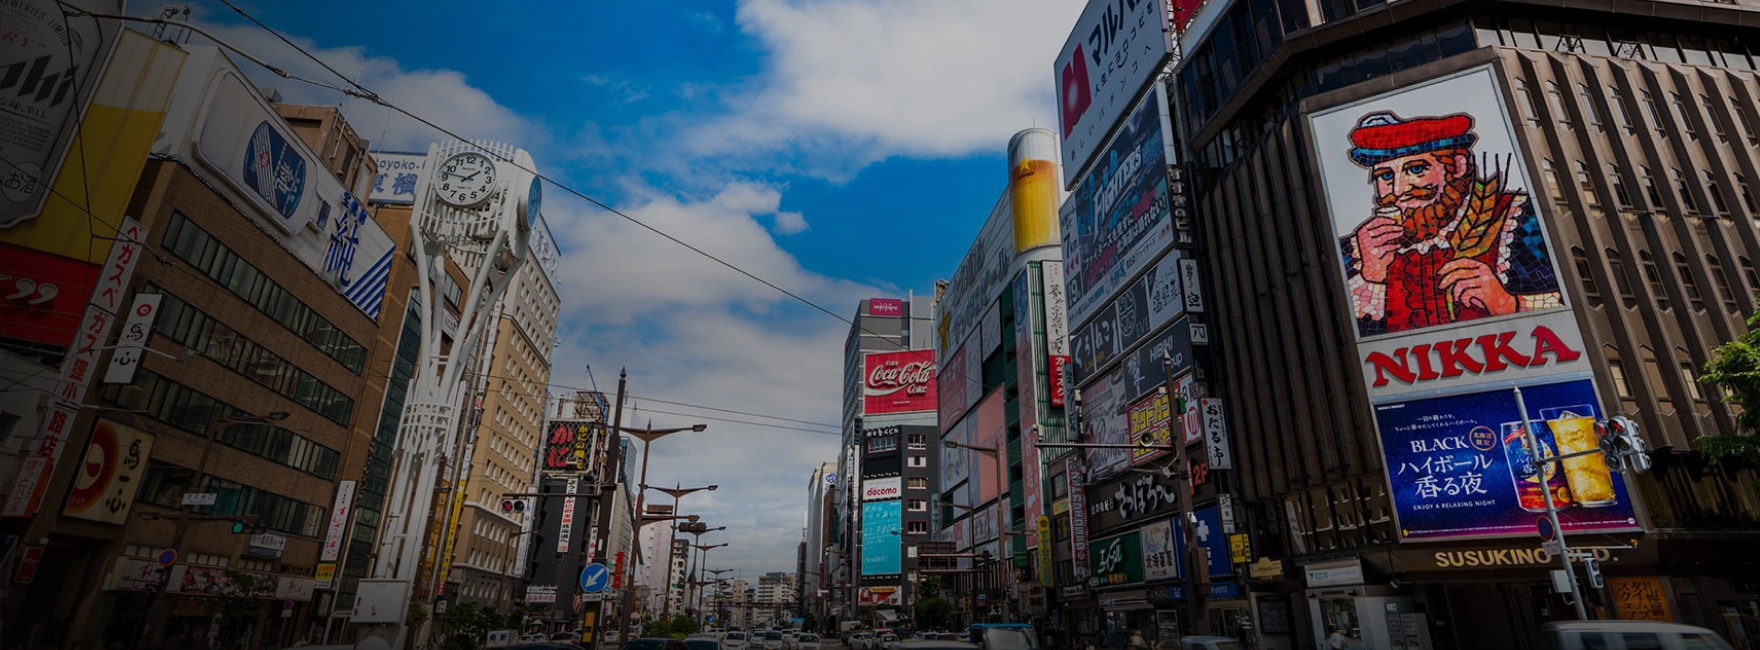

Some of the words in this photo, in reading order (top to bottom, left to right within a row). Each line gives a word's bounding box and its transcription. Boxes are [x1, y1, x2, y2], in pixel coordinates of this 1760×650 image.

[466, 156, 476, 164] 12
[479, 160, 484, 168] 1
[377, 159, 425, 171] oyoko-i
[447, 165, 456, 173] 10
[484, 166, 491, 174] 2
[441, 173, 448, 181] 9
[485, 176, 492, 184] 3
[442, 183, 449, 191] 8
[479, 185, 486, 193] 4
[450, 190, 457, 198] 7
[458, 193, 466, 201] 6
[470, 191, 477, 199] 5
[1150, 336, 1173, 363] HIBIKI
[1365, 325, 1580, 387] NIKKA
[869, 360, 931, 387] Coca-Cola
[907, 384, 928, 394] Coke
[549, 424, 574, 469] かに
[1410, 436, 1469, 453] BLACK
[1397, 453, 1493, 479] ハイボール
[1193, 463, 1207, 486] 2F
[1414, 472, 1488, 499] 香る夜
[867, 487, 897, 496] docomo
[1441, 500, 1473, 509] RELAXING
[1474, 499, 1495, 507] NIGHT
[1433, 547, 1552, 568] SUSUKINO
